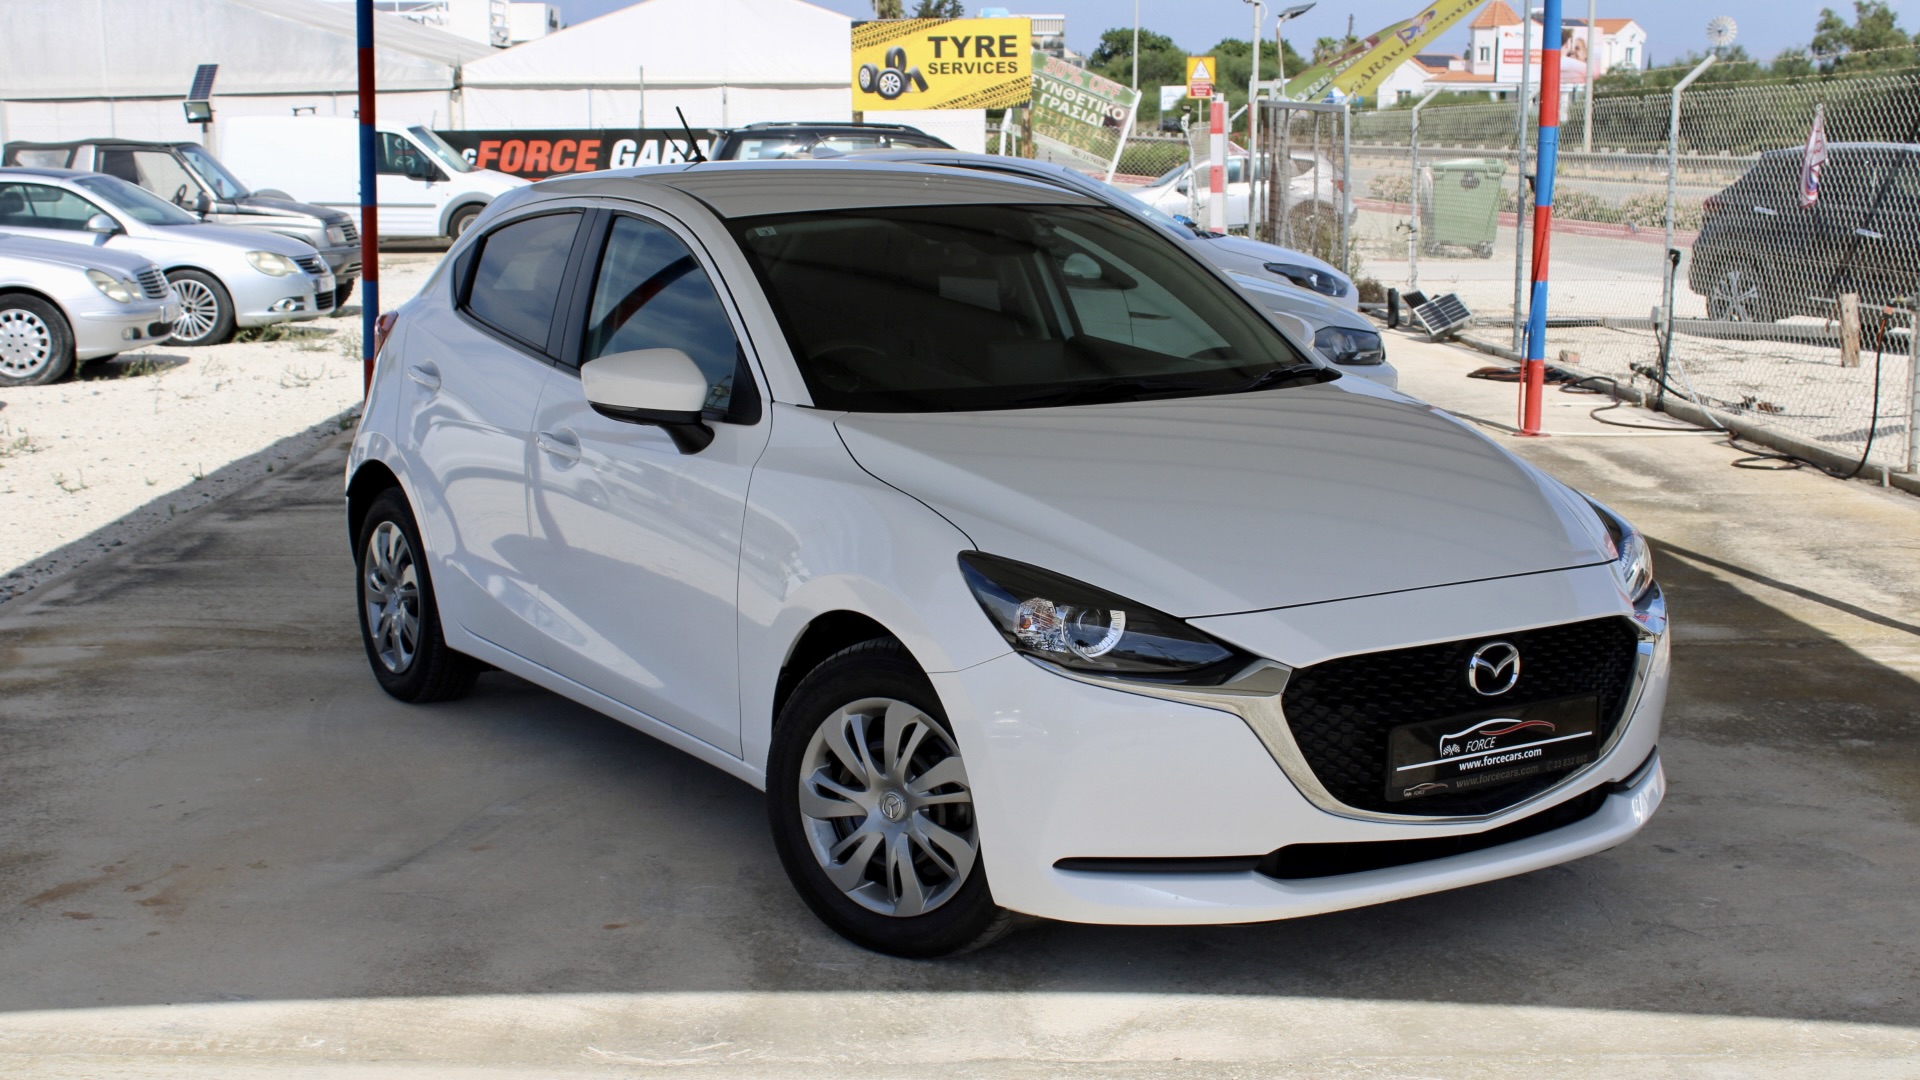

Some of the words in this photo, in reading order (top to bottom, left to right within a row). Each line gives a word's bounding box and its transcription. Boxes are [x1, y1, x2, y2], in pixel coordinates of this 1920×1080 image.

[927, 35, 1018, 58] TYRE
[928, 61, 1018, 75] SERVICES
[1043, 56, 1083, 86] 30%
[1089, 75, 1121, 98] OFF
[1039, 92, 1105, 127] ΓΡΑΣΙΔΙ
[1033, 105, 1111, 144] RTIFICIAL
[1036, 122, 1091, 152] GRASS
[475, 139, 601, 172] FORCE
[1465, 736, 1497, 753] FORCE
[1459, 748, 1542, 771] www.forcecars.com
[1456, 765, 1539, 788] www.forcecars.com
